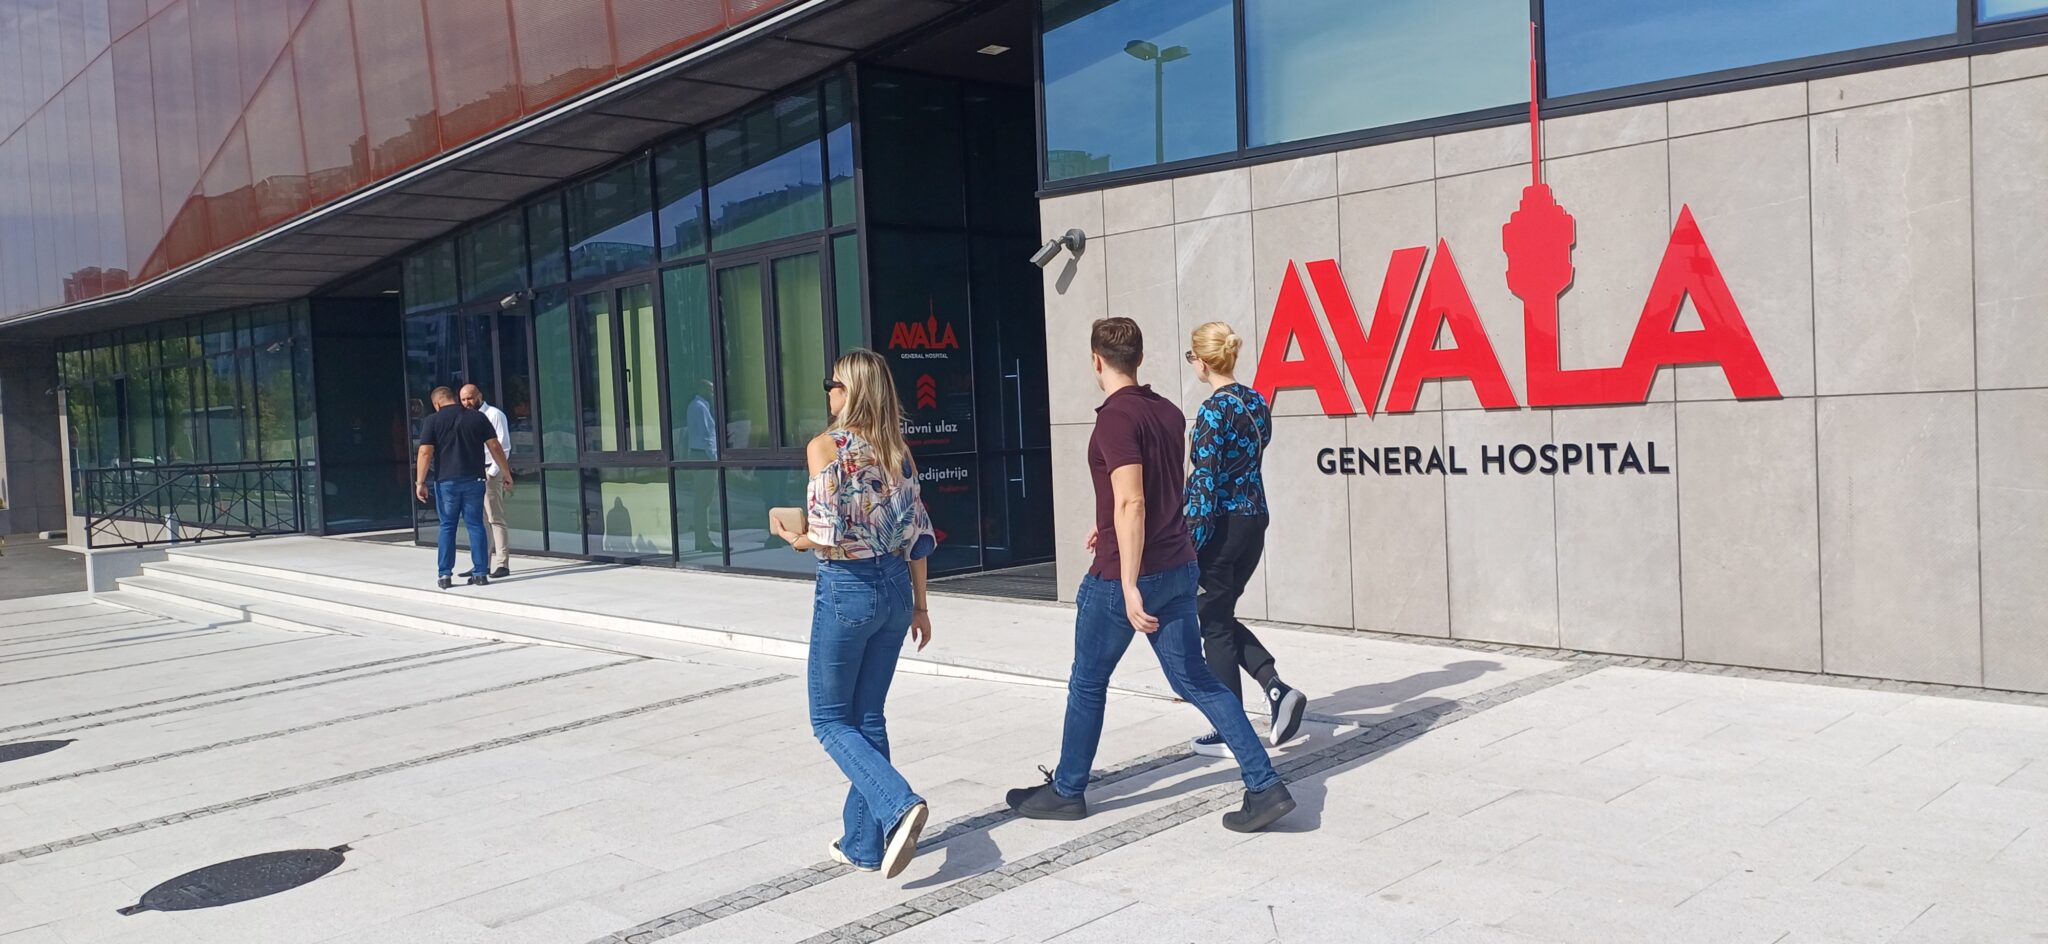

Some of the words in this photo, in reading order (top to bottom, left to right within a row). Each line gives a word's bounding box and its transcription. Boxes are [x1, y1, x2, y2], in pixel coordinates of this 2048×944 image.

[1252, 22, 1784, 420] AVALA
[889, 295, 959, 349] AVALA
[935, 420, 958, 432] ulaz
[919, 467, 968, 482] edijatrija
[1316, 446, 1467, 475] GENERAL
[1481, 442, 1670, 473] HOSPITAL
